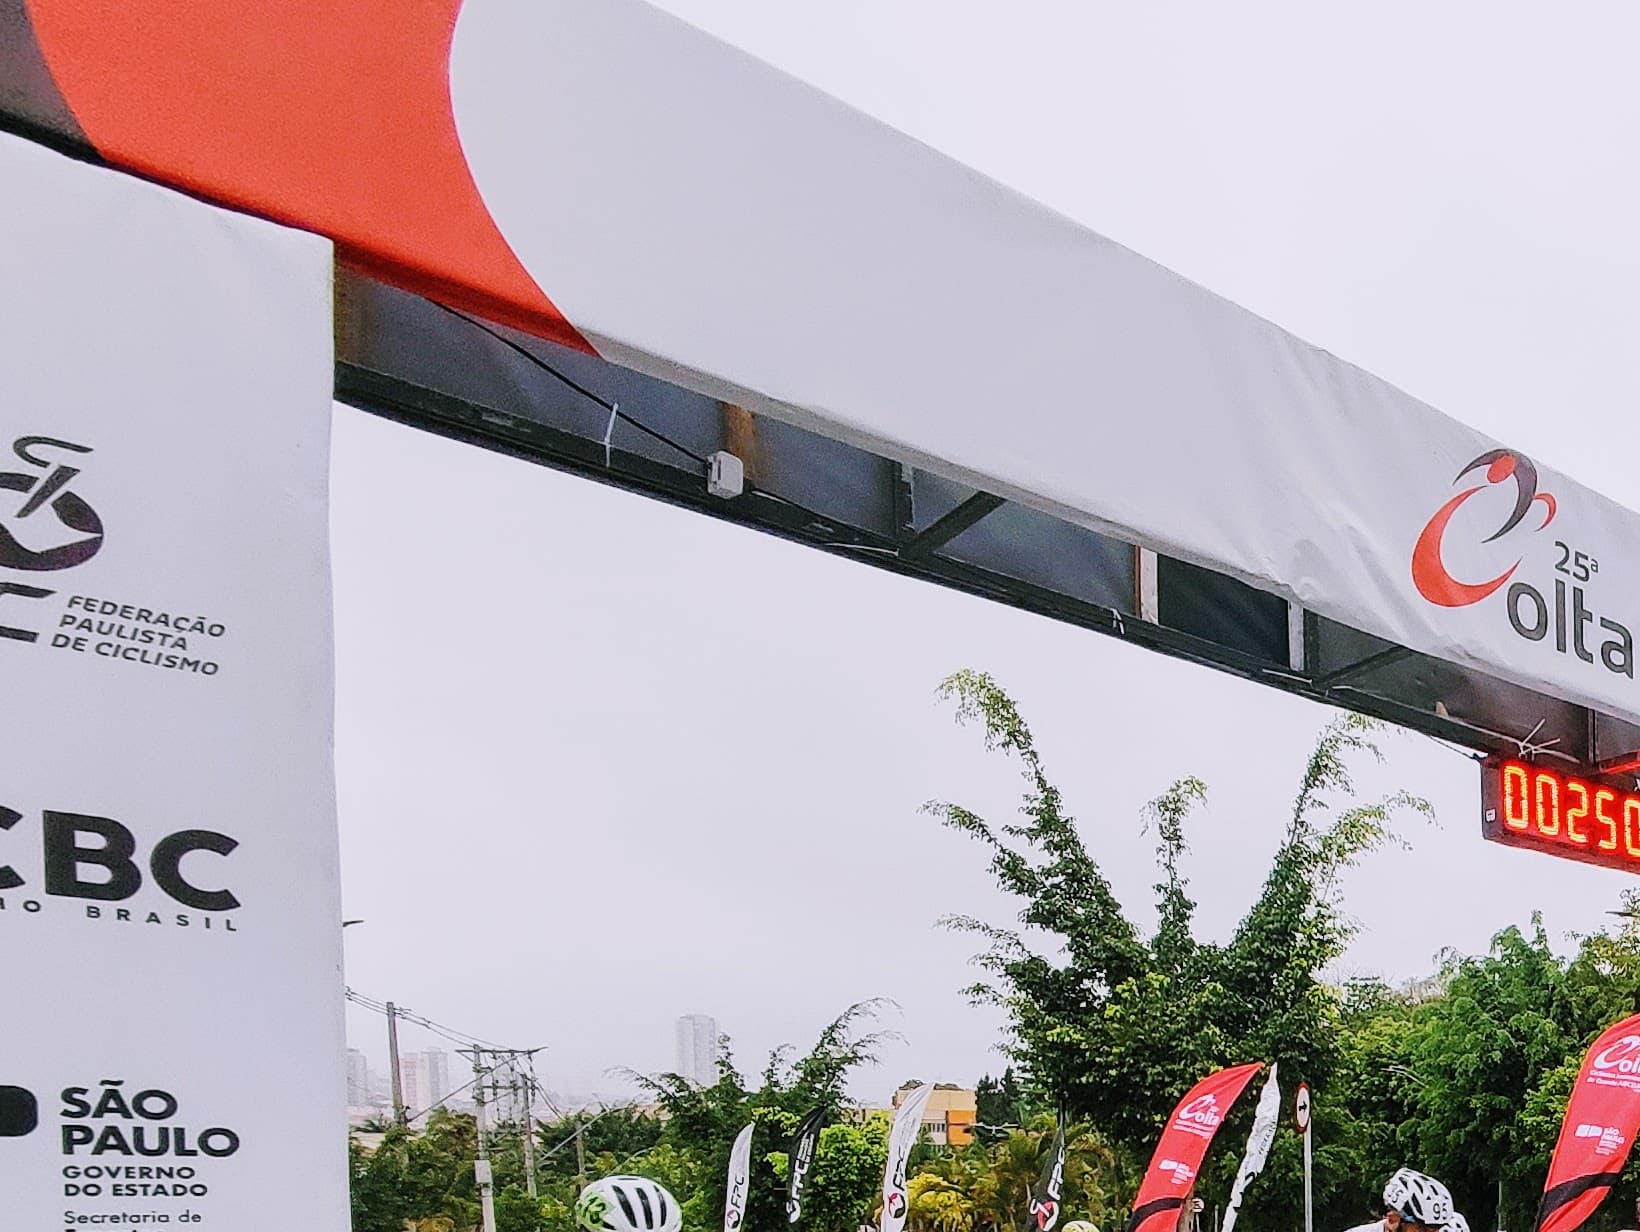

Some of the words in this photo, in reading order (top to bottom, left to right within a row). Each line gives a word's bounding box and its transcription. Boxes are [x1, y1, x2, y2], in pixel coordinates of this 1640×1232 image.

[58, 613, 189, 651] PAULISTA
[67, 594, 227, 638] FEDERAÇÃO
[51, 632, 88, 652] DE
[94, 641, 220, 677] CICLISMO
[0, 803, 242, 912] BC
[86, 904, 238, 933] BRASIL
[60, 1080, 179, 1121] SÃO
[61, 1124, 241, 1159] PAULO
[62, 1165, 196, 1181] GOVERNO
[64, 1183, 101, 1198] DO
[112, 1183, 209, 1198] ESTADO
[63, 1210, 170, 1226] Secretaria
[178, 1210, 203, 1226] de
